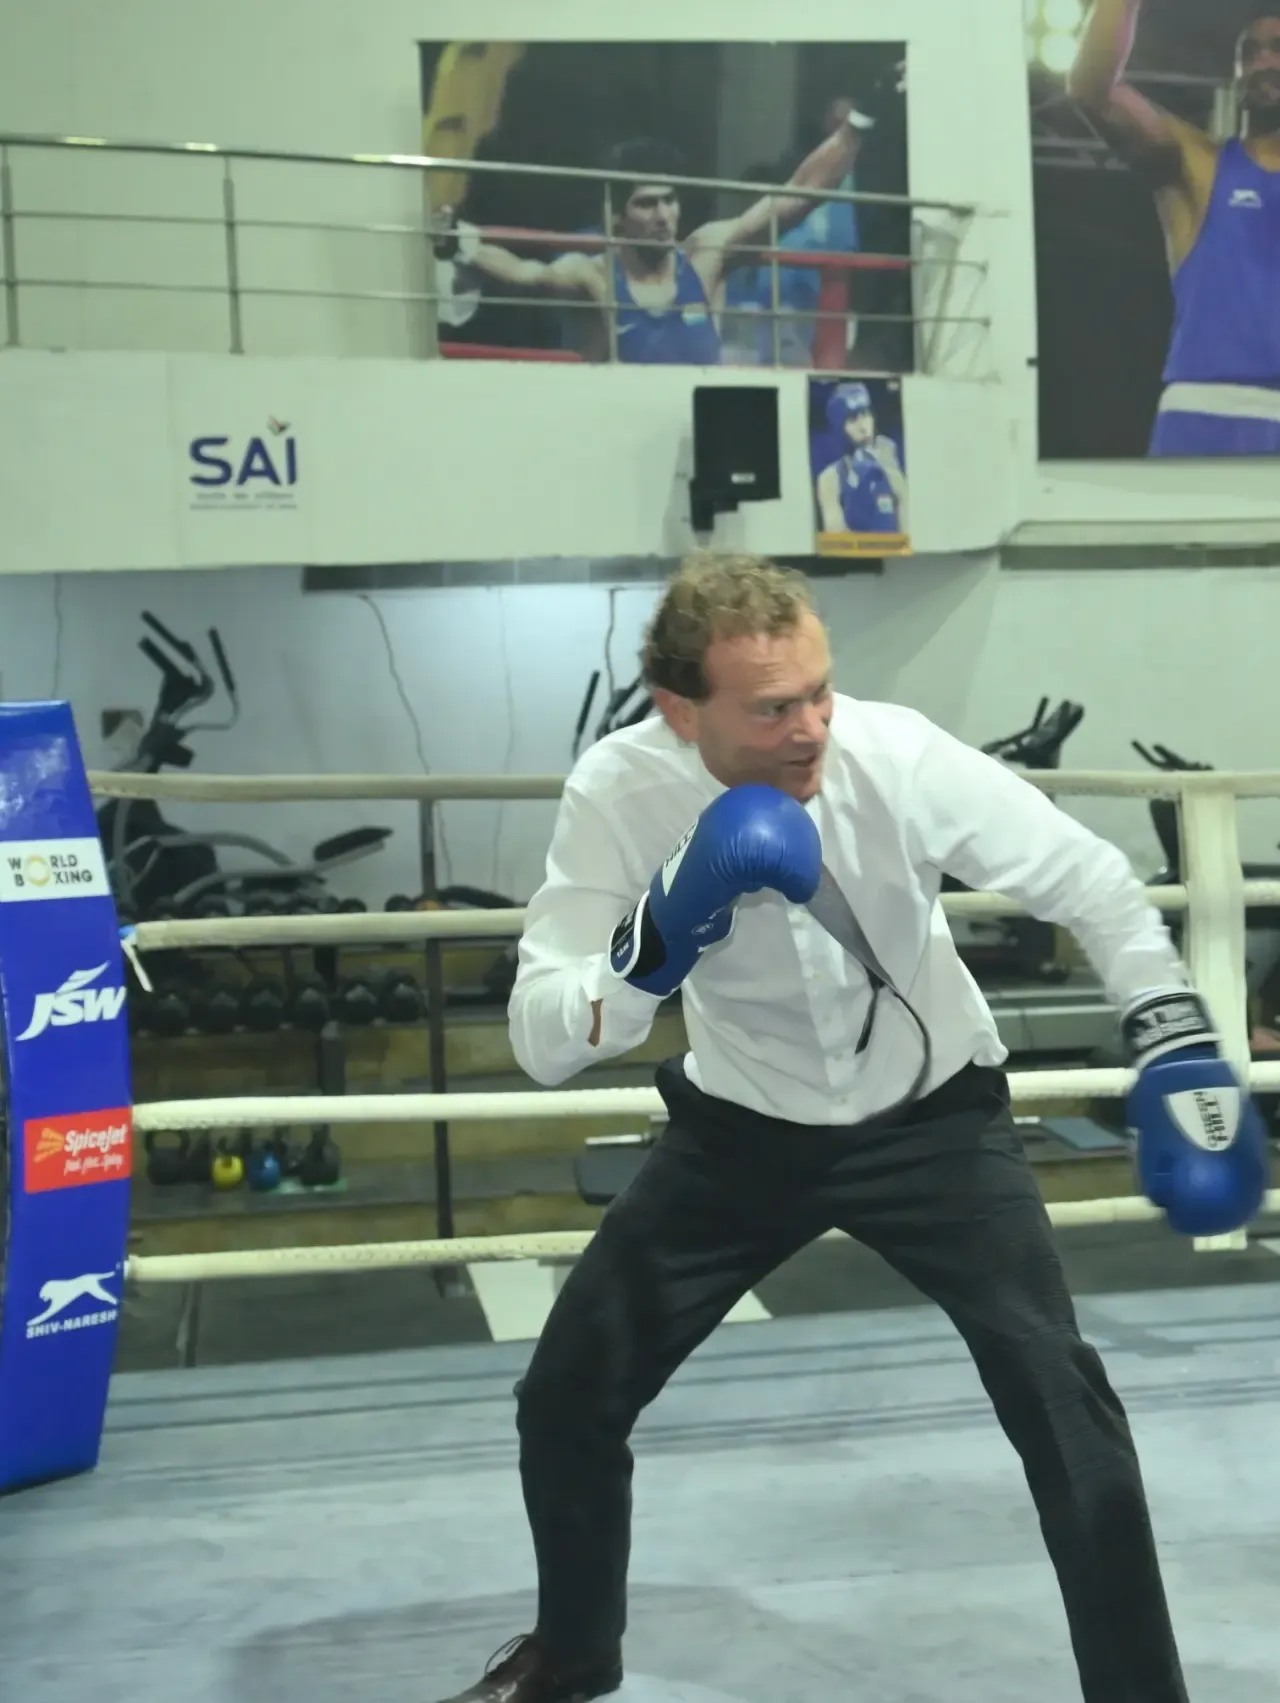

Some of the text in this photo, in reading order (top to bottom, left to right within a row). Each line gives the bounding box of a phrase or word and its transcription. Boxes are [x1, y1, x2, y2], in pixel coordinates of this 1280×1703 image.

[189, 436, 298, 487] SAI
[7, 853, 79, 871] WORLD
[13, 868, 94, 888] BOXING
[15, 982, 127, 1041] JSW
[64, 1123, 128, 1157] SpiceJet
